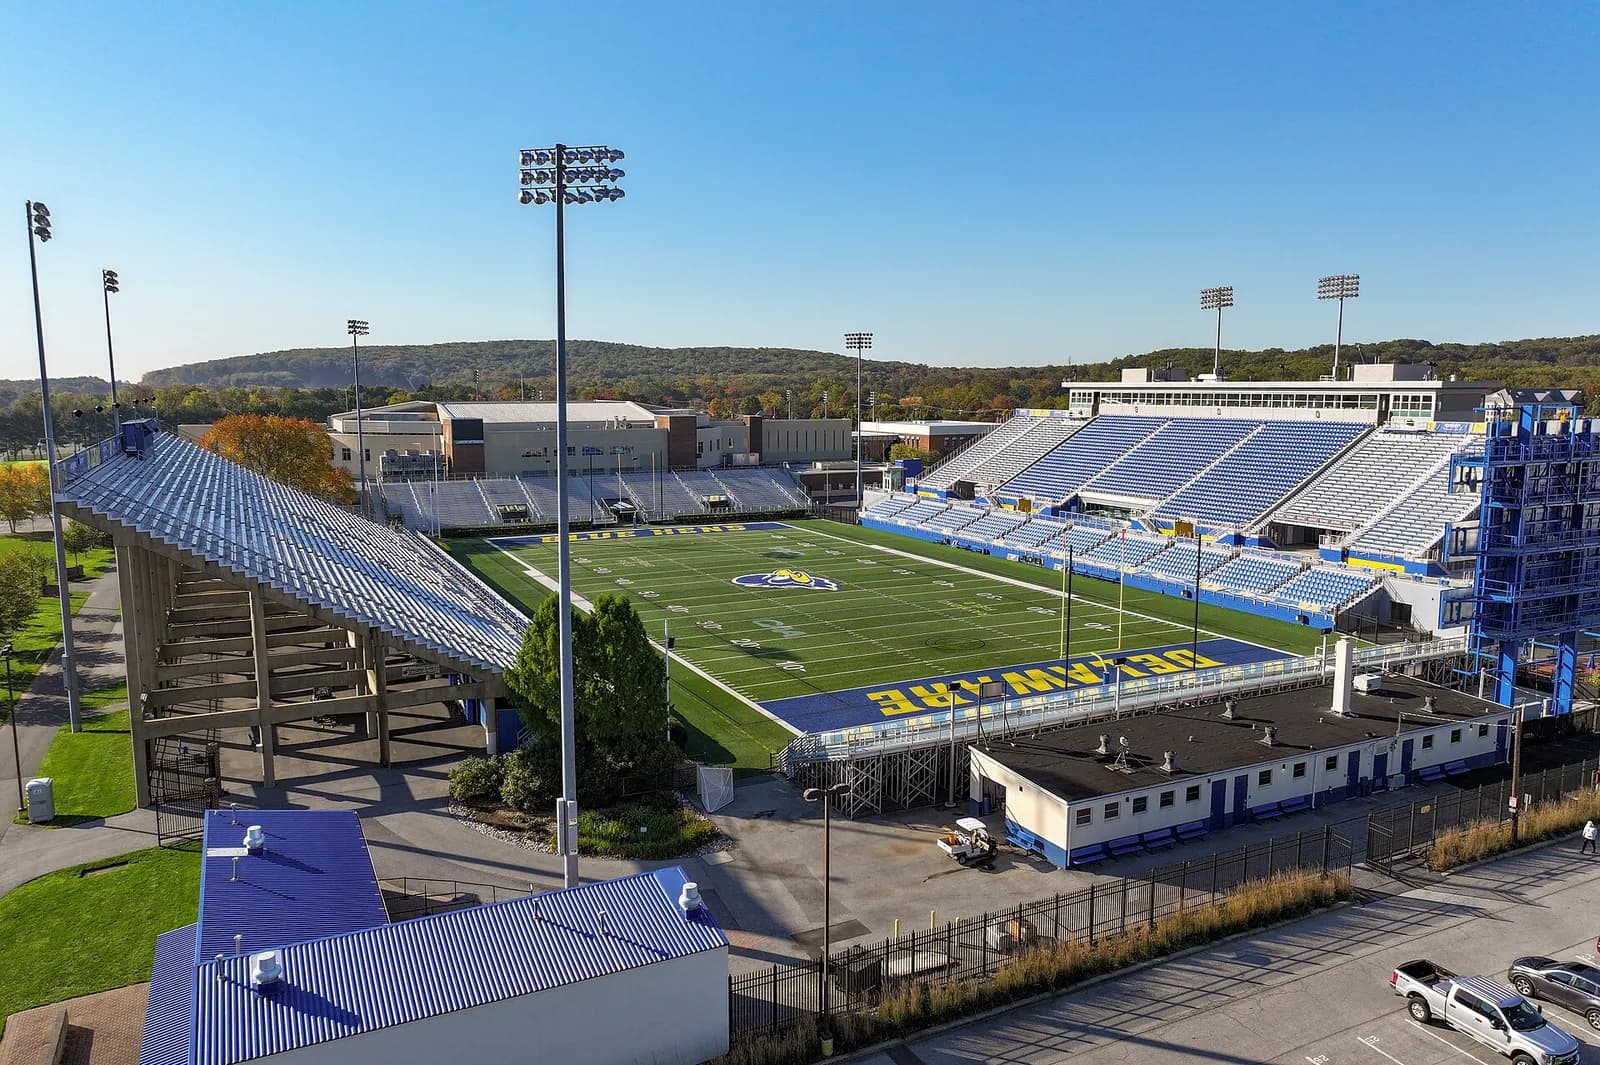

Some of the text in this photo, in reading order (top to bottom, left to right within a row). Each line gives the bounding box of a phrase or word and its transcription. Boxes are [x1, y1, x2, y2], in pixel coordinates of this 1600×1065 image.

[541, 525, 746, 543] BLUE HENS
[730, 638, 761, 650] 20
[776, 660, 807, 673] 10
